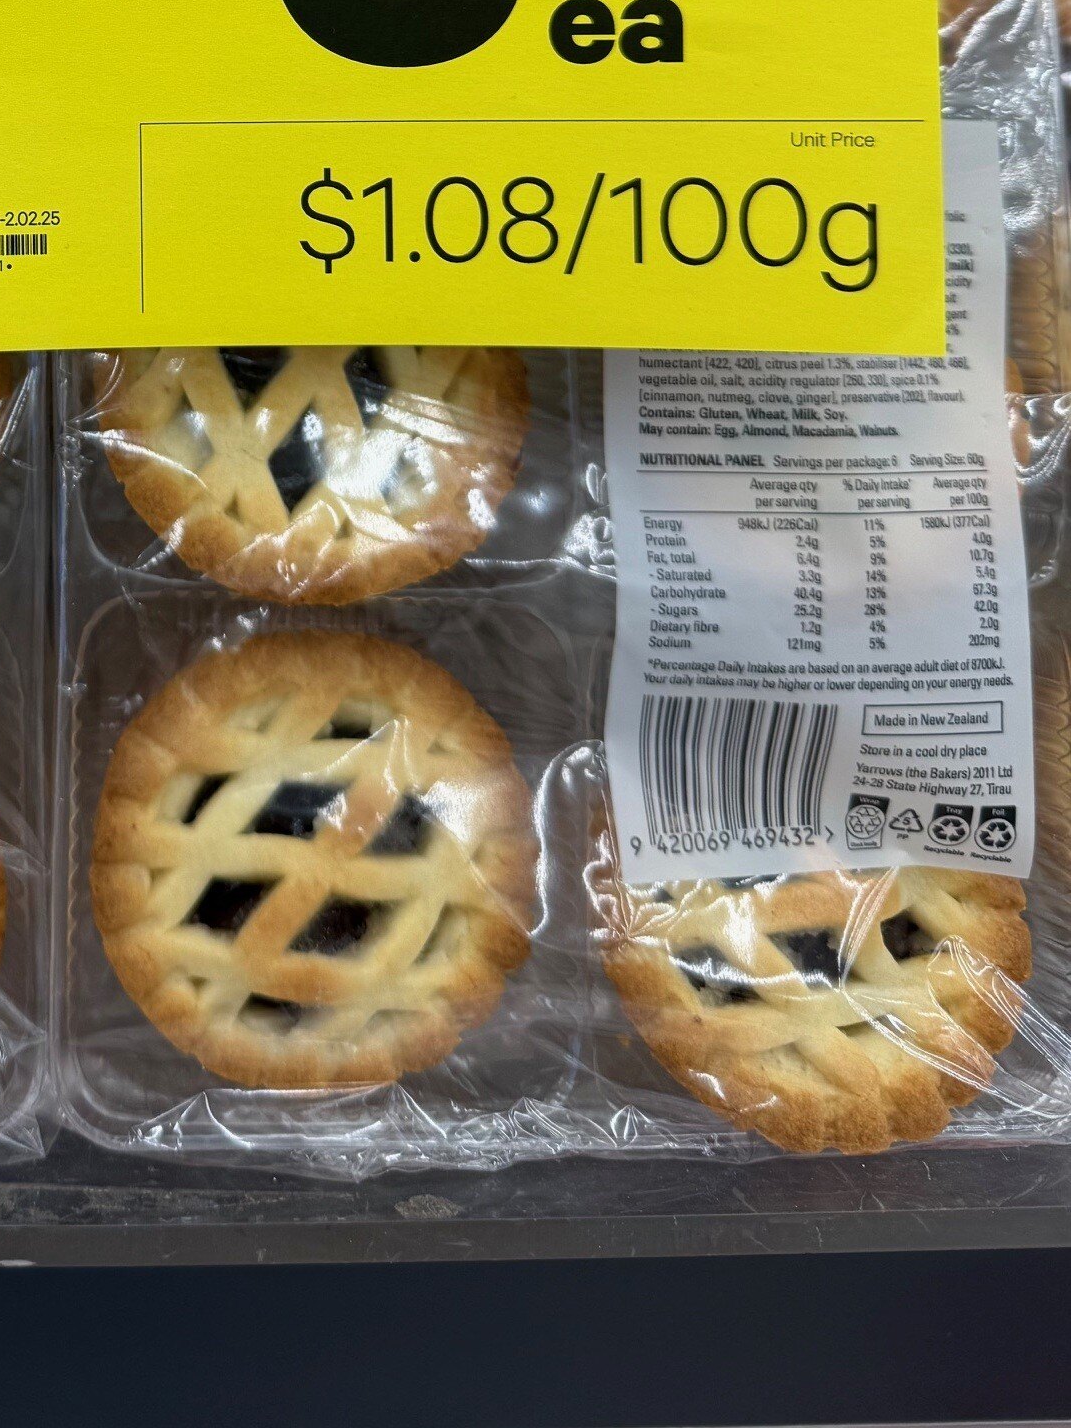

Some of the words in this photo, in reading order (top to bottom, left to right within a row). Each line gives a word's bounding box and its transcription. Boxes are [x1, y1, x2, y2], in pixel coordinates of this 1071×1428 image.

[790, 132, 826, 147] Unit
[831, 132, 875, 147] Price
[297, 166, 880, 293] $1.08/100g
[638, 405, 695, 419] Contains:
[698, 407, 743, 421] Gluten,
[746, 408, 789, 421] Wheat,
[792, 408, 821, 421] Milk,
[824, 408, 848, 423] Soy.
[874, 714, 906, 727] Made
[908, 714, 918, 726] in
[920, 713, 946, 726] New
[947, 711, 989, 725] Zealand
[859, 743, 891, 757] Store
[892, 745, 903, 757] in
[905, 748, 913, 758] a
[915, 745, 938, 758] cool
[940, 745, 957, 759] dry
[959, 744, 987, 759] place
[855, 762, 904, 777] Yarrows
[905, 765, 927, 780] (the
[929, 764, 971, 780] Bakers)
[973, 765, 995, 778] 2011
[997, 765, 1013, 778] Ltd
[630, 837, 642, 856] 9
[656, 828, 730, 856] 420069
[741, 825, 815, 850] 469432
